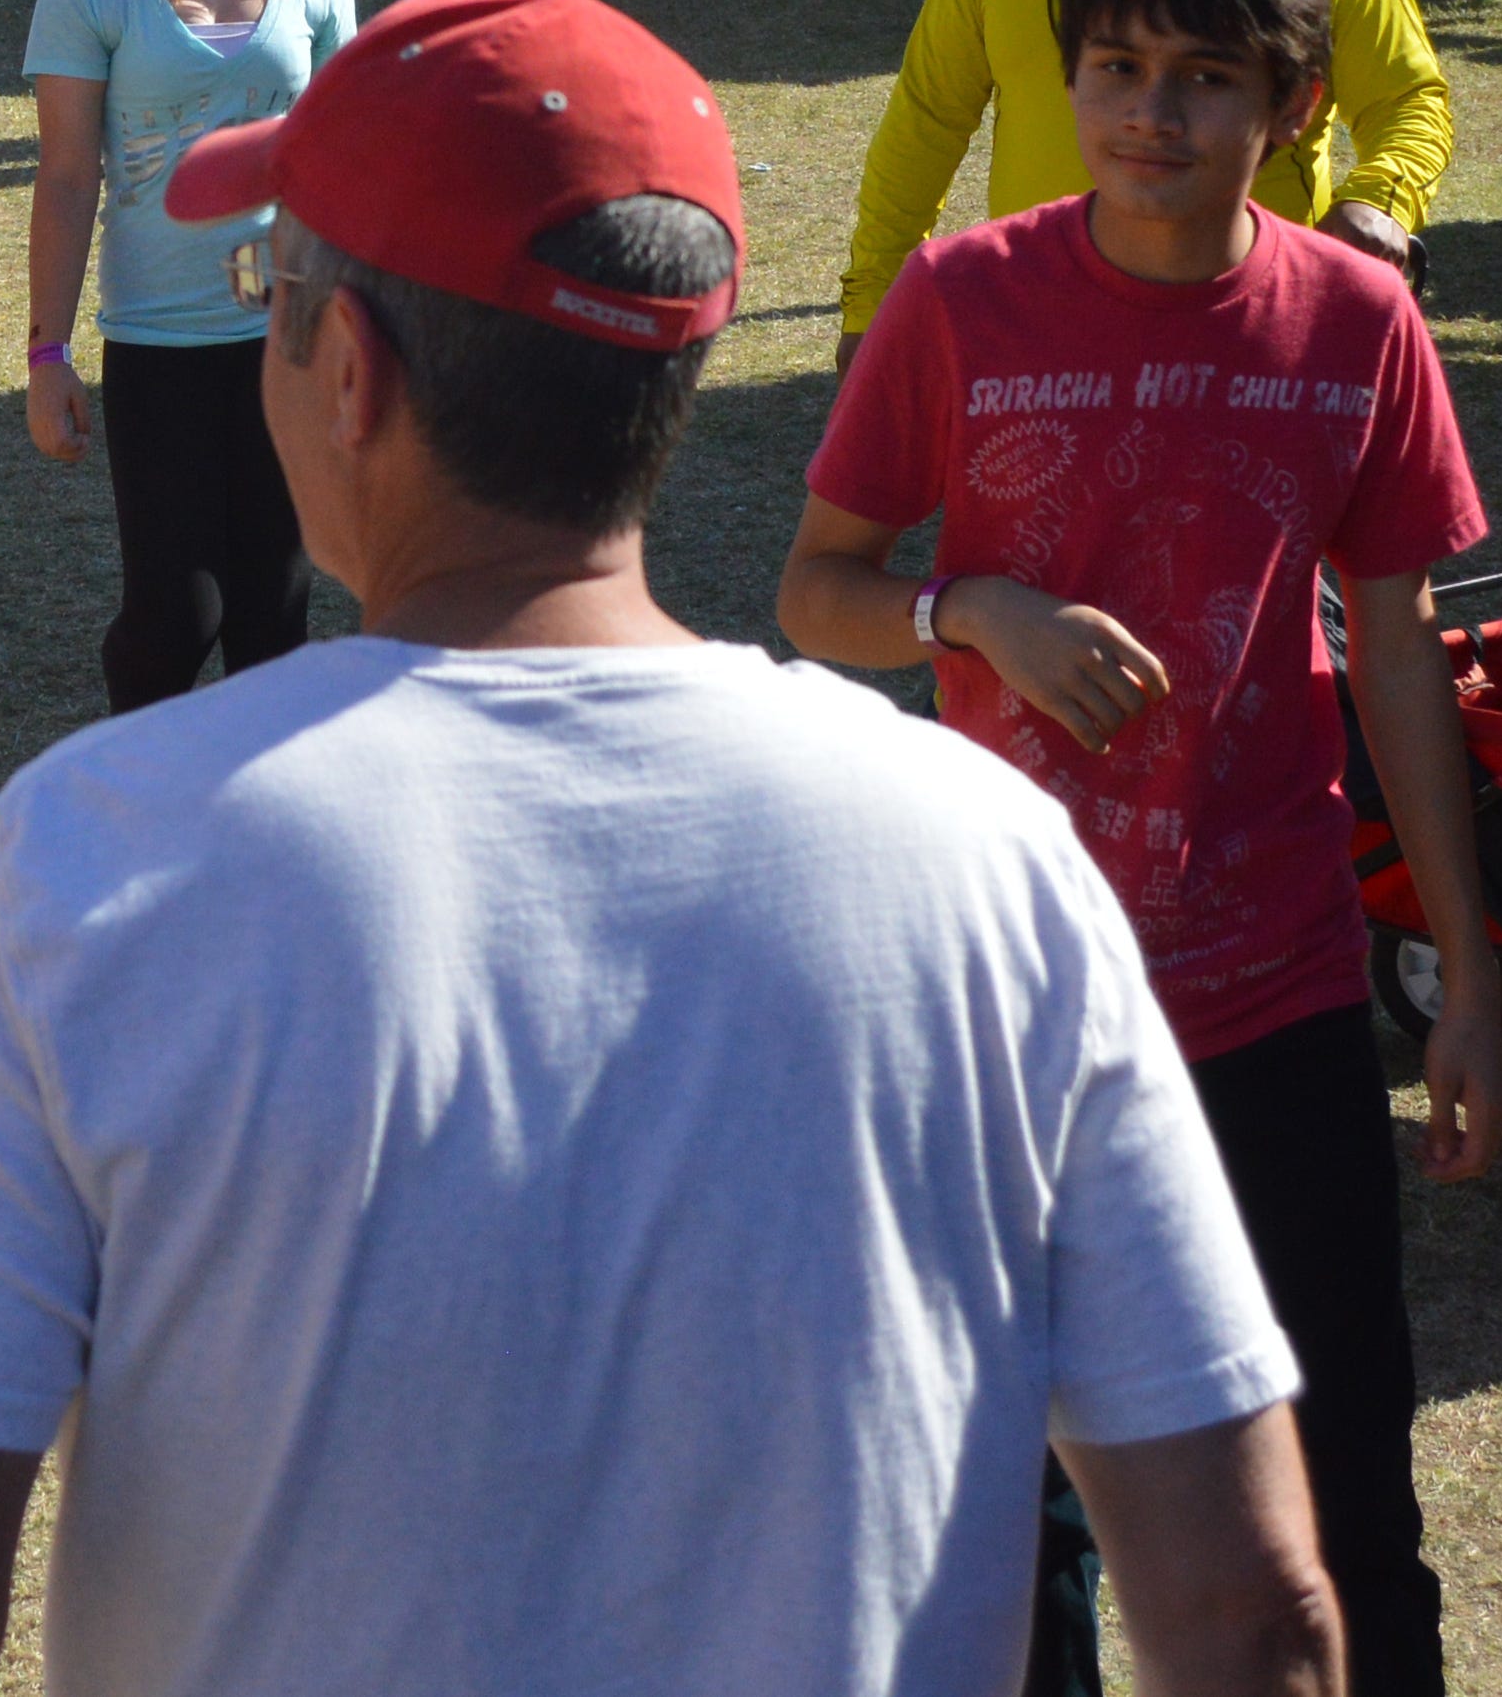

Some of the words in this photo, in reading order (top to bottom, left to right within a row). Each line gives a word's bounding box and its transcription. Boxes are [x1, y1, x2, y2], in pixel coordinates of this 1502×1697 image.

[966, 371, 1113, 417] SRIRACHA
[1134, 362, 1216, 409] HOT
[1227, 374, 1304, 411] CHILI
[1312, 379, 1378, 417] SAUC
